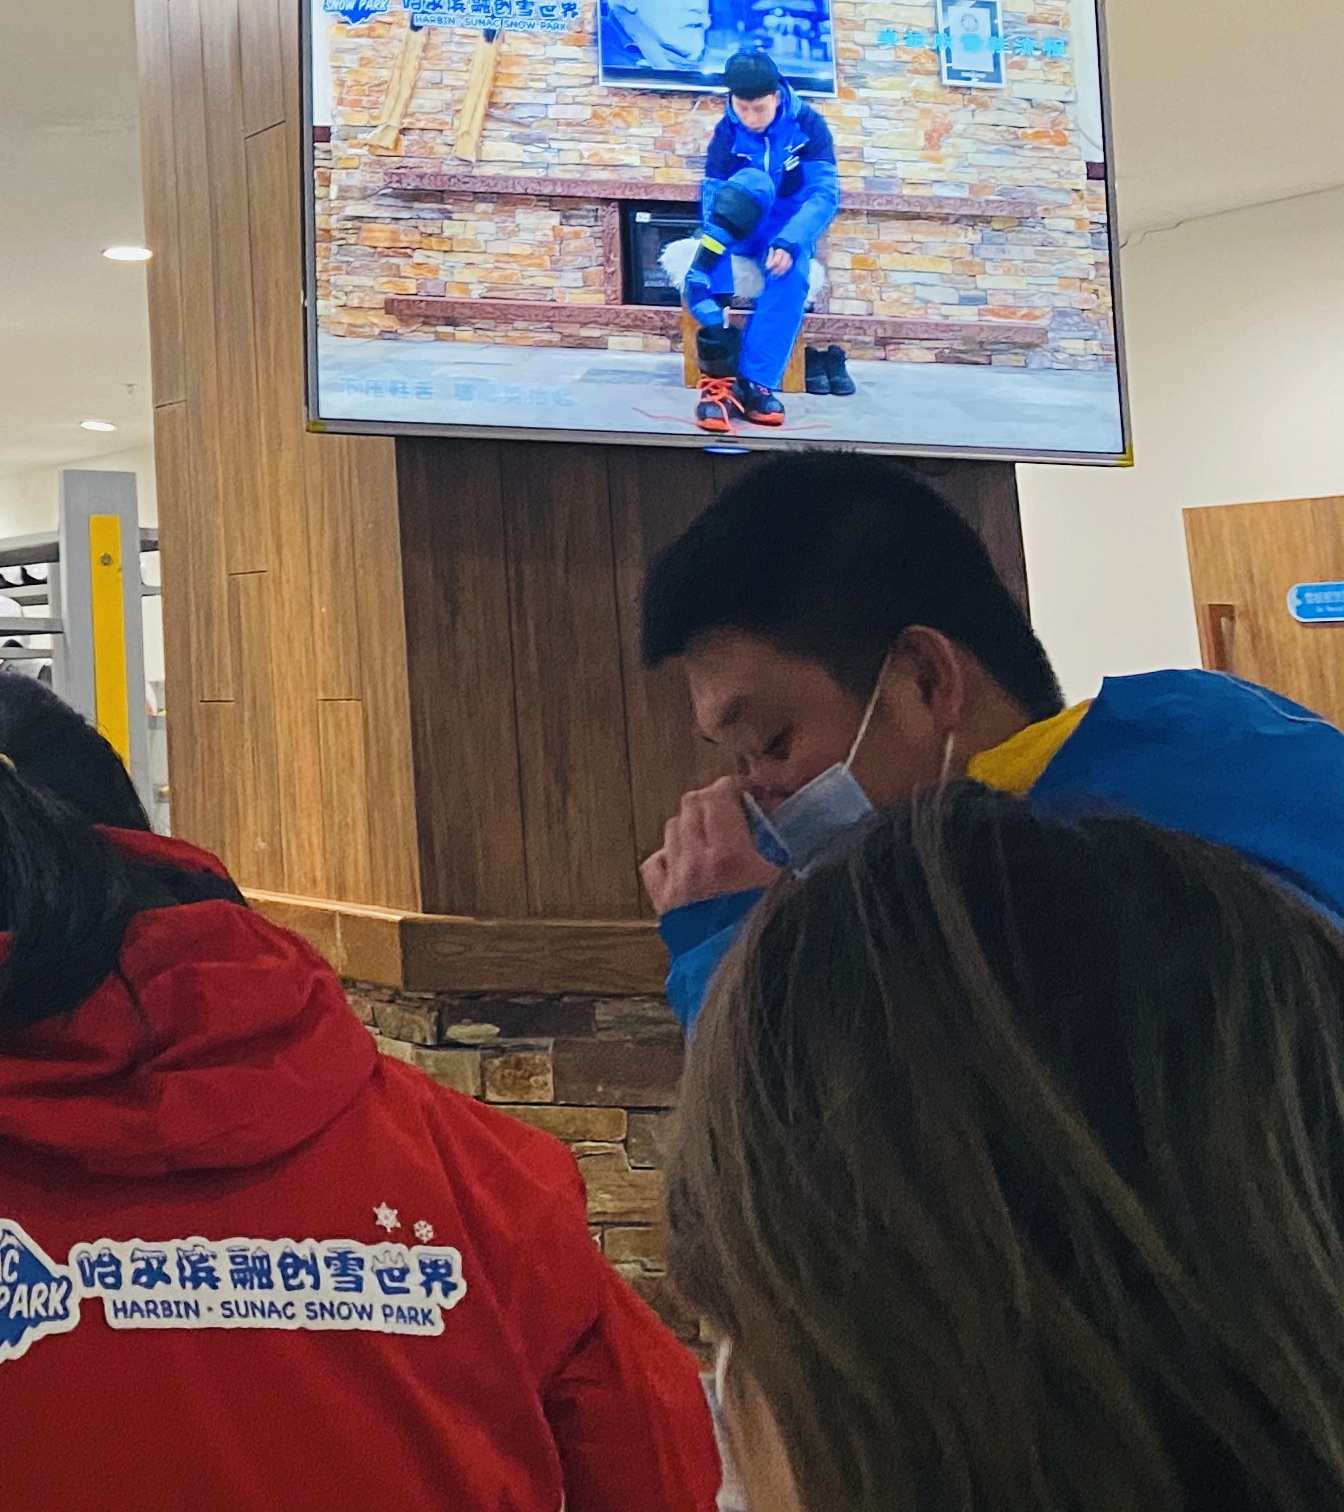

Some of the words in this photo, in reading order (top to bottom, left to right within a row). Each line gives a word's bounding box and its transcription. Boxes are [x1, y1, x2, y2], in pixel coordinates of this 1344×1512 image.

[415, 14, 457, 26] HARBIN
[503, 19, 536, 29] SNOW
[539, 20, 567, 31] PARK
[76, 1245, 459, 1299] 哈尔滨融创雪世界
[113, 1299, 201, 1320] HARBIN
[220, 1300, 296, 1321] SUNAC
[305, 1300, 374, 1322] SNOW
[381, 1304, 435, 1326] PARK
